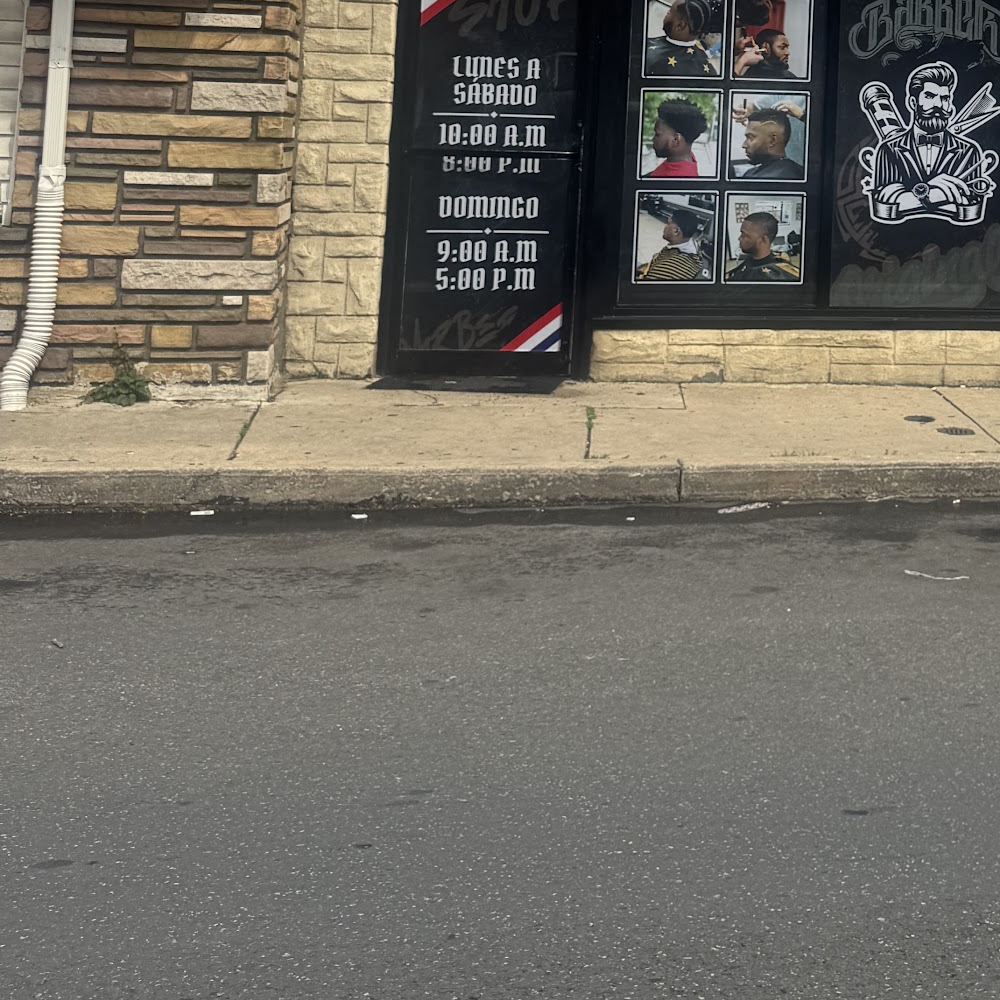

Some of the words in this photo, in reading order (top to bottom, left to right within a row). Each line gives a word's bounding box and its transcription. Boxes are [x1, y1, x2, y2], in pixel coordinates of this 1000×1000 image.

[452, 55, 520, 80] LUNES
[525, 57, 541, 80] A
[453, 77, 537, 106] SÁBADO
[438, 123, 498, 146] 10:00
[438, 195, 540, 219] DOMINGO
[436, 239, 488, 263] 9:00
[435, 267, 486, 291] 5:00
